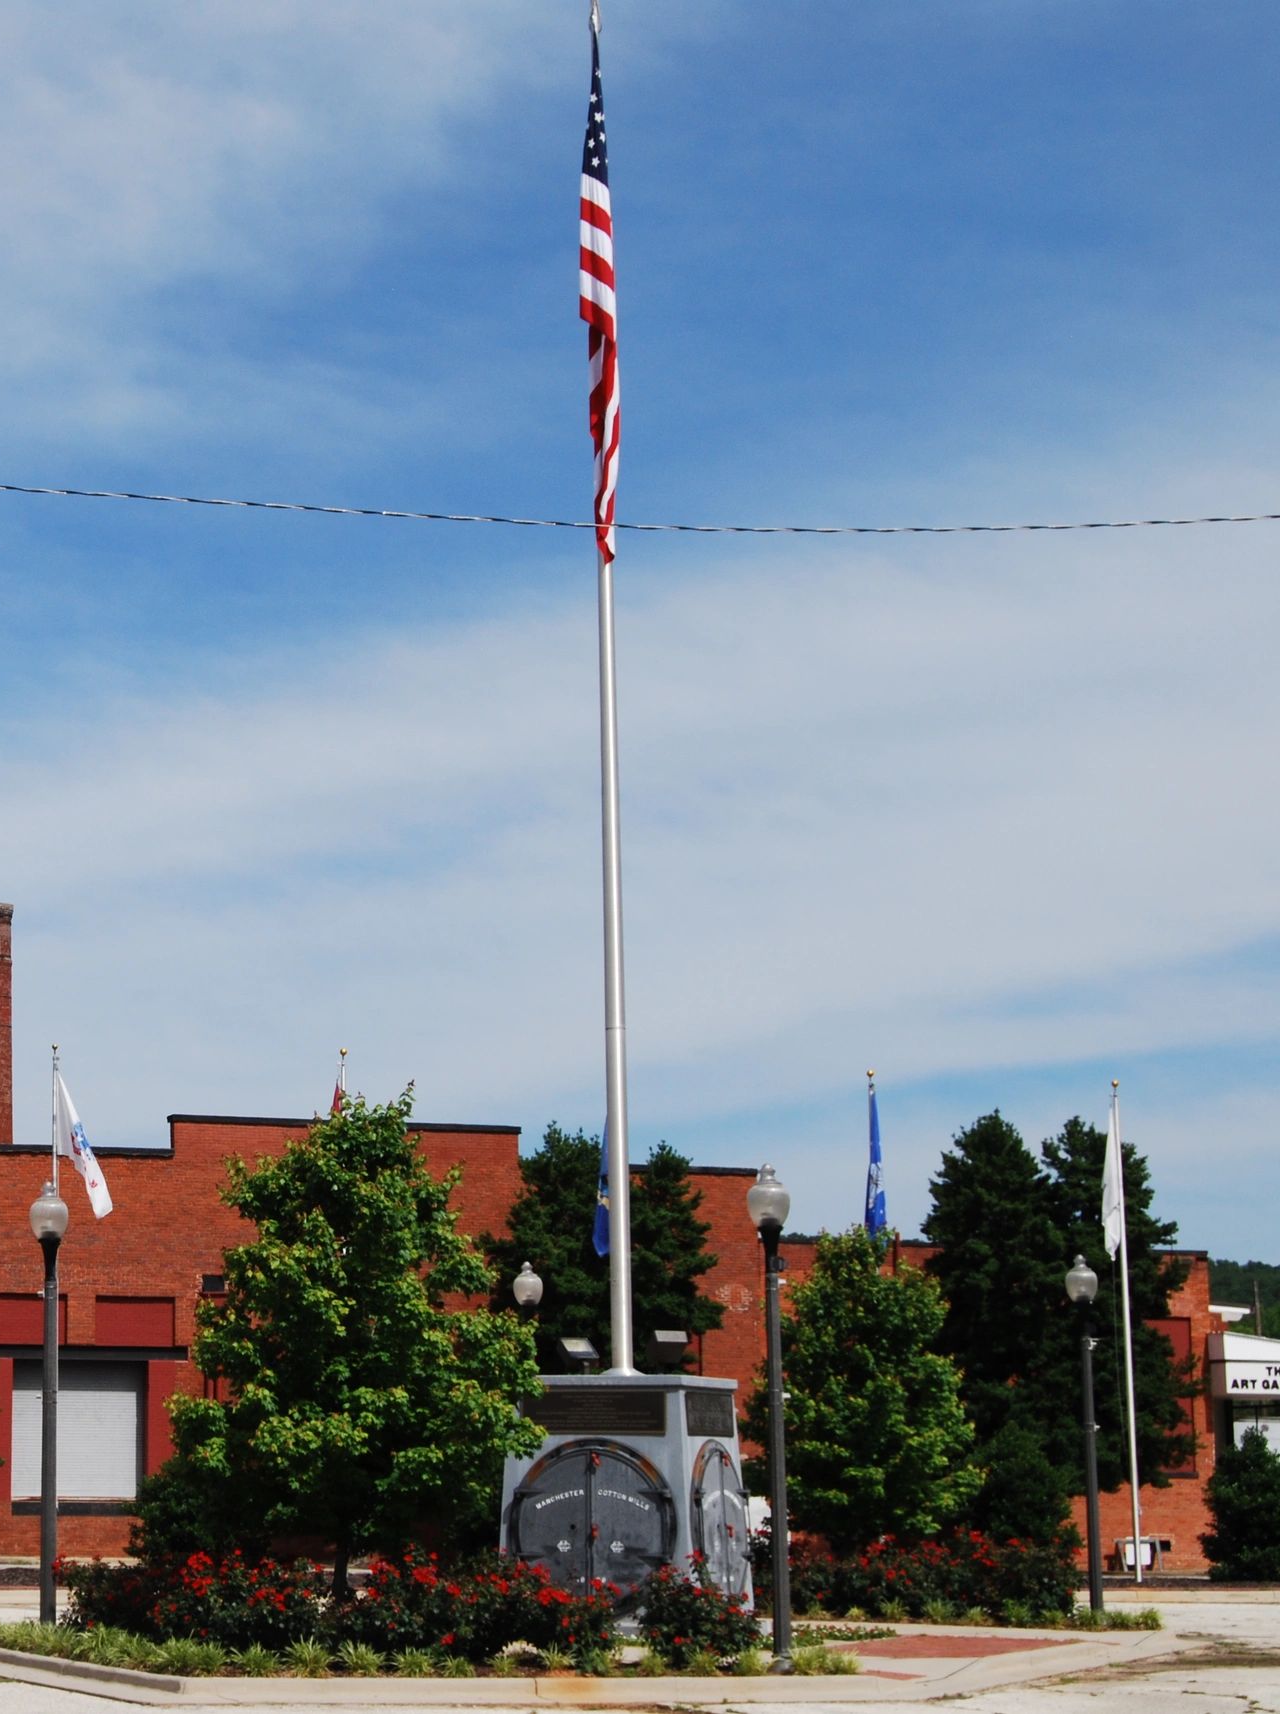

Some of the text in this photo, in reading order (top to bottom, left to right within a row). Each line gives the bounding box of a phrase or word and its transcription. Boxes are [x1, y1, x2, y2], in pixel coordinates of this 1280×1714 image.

[1231, 1379, 1257, 1389] ART
[535, 1488, 650, 1511] MANCHESTER COTTON MILLS
